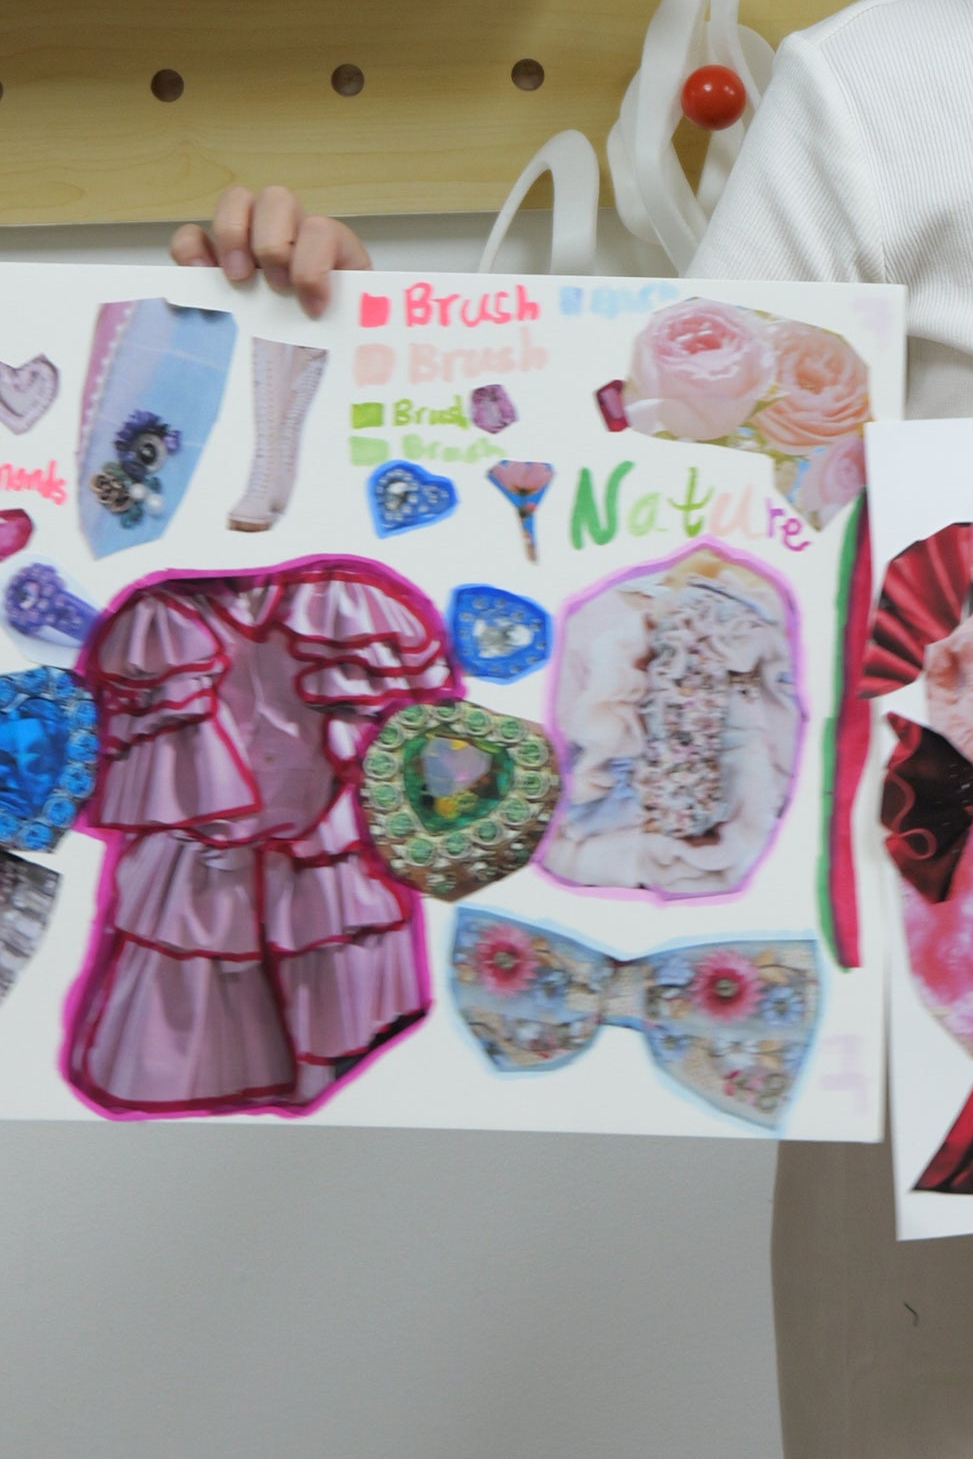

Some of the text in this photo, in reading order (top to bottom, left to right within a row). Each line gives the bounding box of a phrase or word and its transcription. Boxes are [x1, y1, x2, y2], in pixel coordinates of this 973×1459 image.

[404, 282, 540, 327] Brush
[408, 326, 548, 383] Brush
[571, 460, 812, 551] Nature
